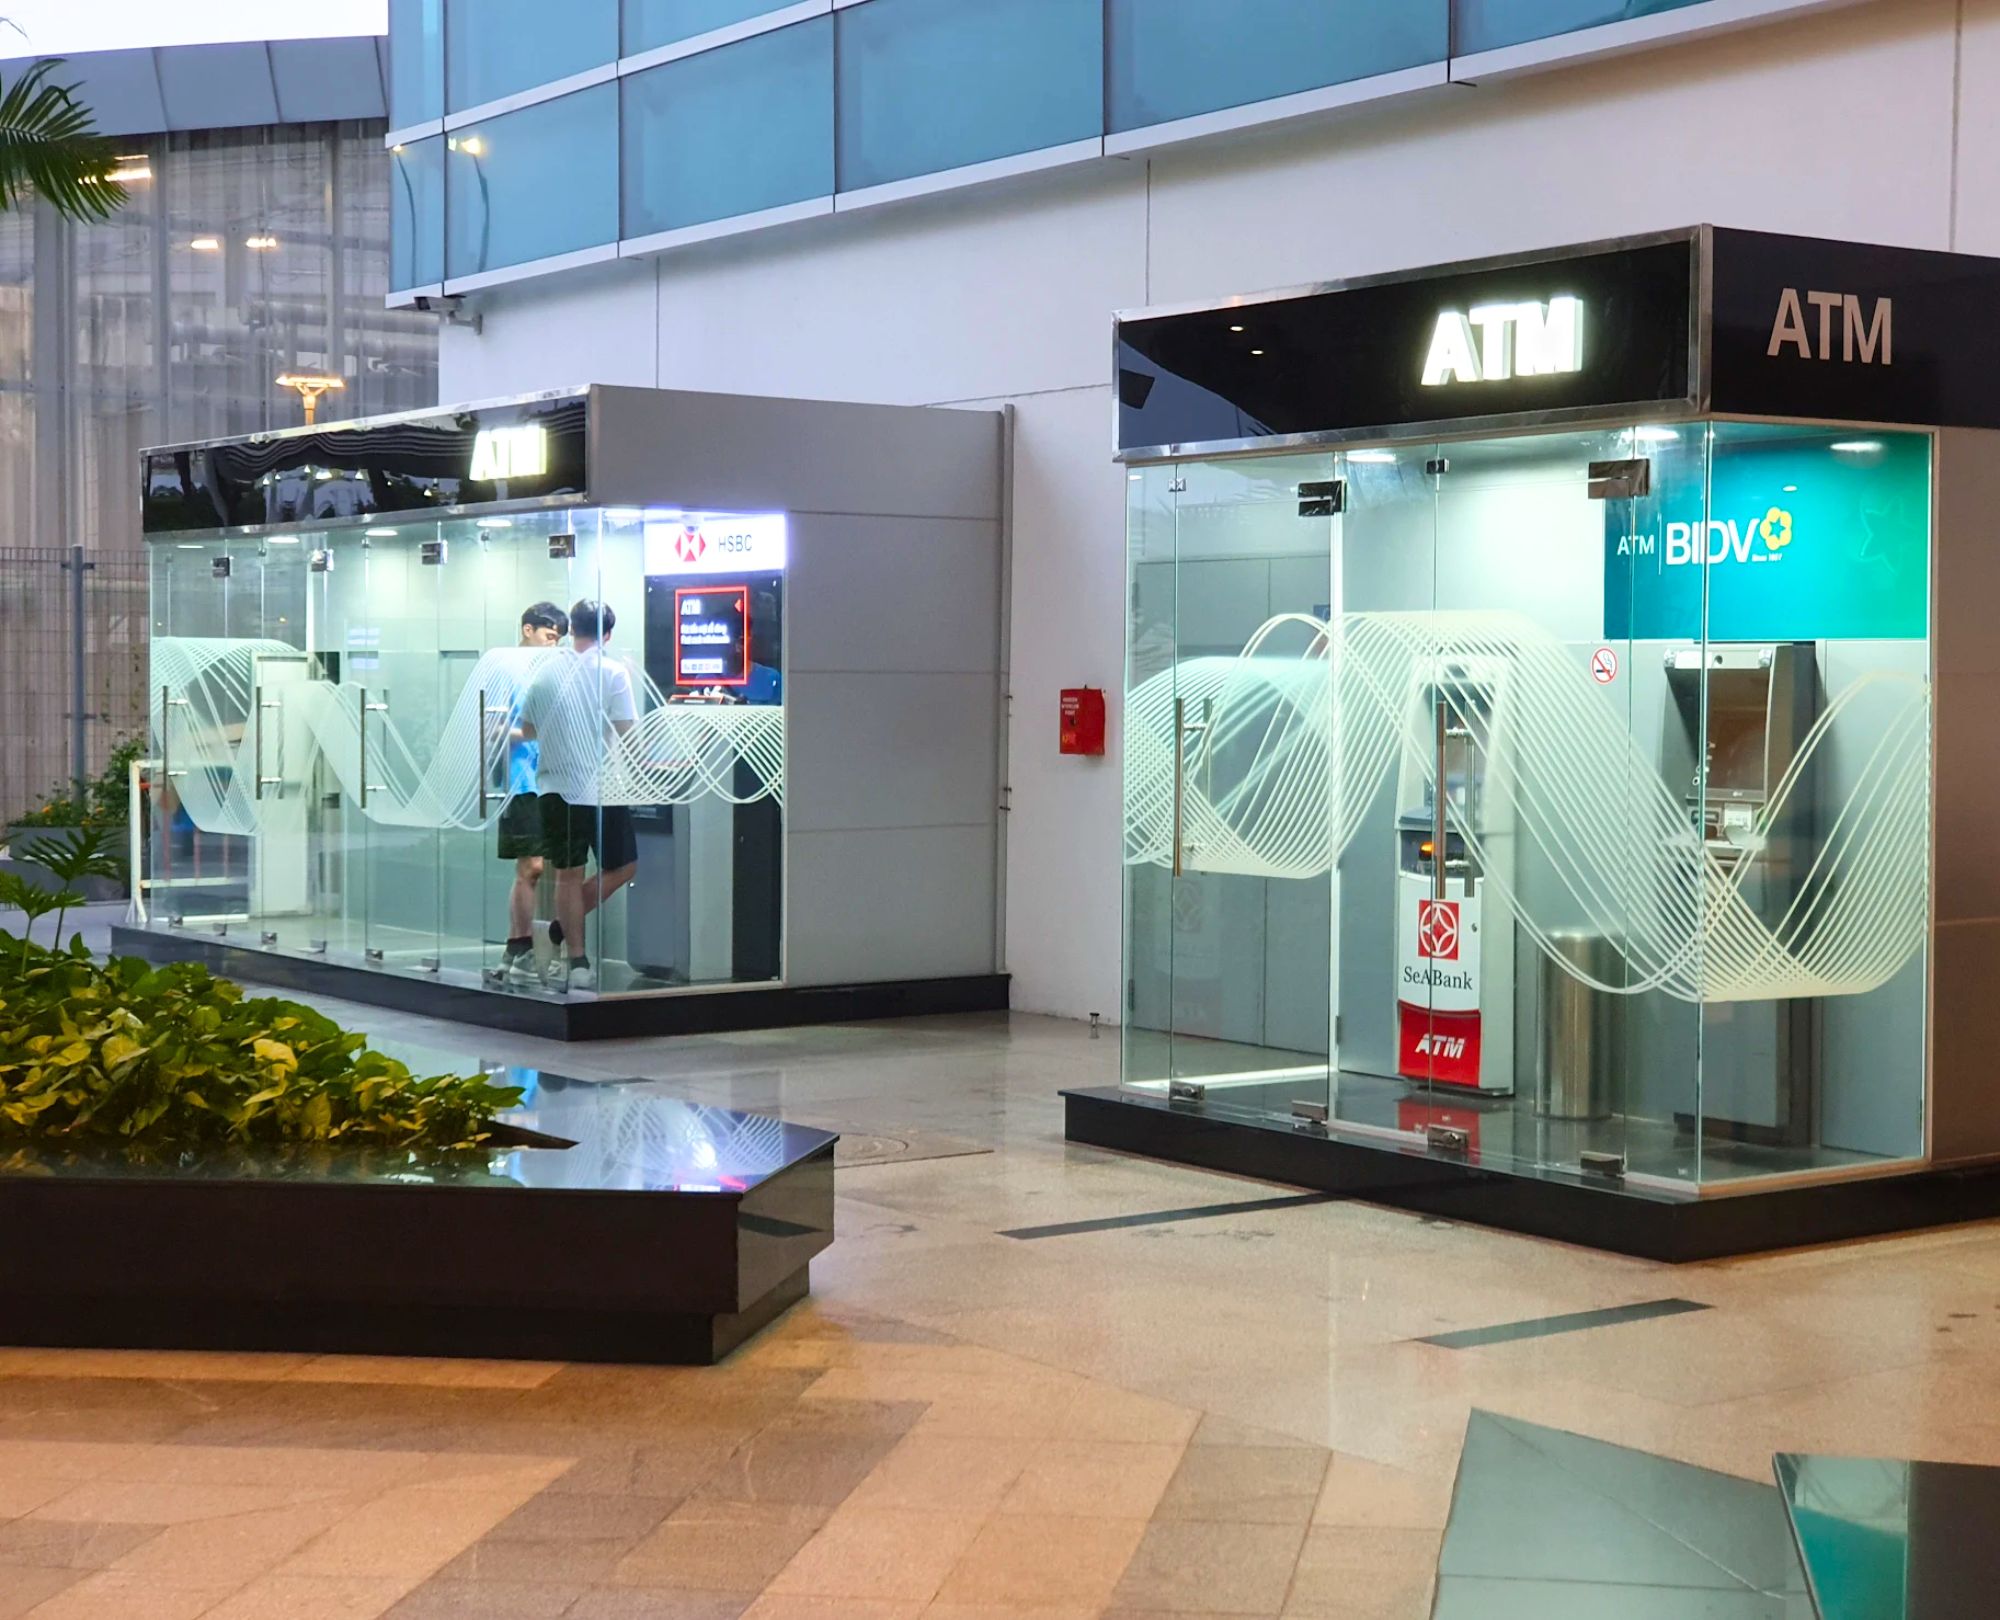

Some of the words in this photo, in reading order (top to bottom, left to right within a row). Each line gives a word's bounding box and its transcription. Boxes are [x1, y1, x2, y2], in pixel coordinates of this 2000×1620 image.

[1420, 296, 1584, 386] ATM
[1767, 287, 1892, 365] ATM
[469, 424, 547, 481] ATM
[718, 534, 753, 552] HSBC
[1617, 534, 1655, 556] ATM
[1665, 519, 1760, 565] BIDV
[1404, 967, 1472, 989] SeABank
[1416, 1034, 1465, 1059] ATM
